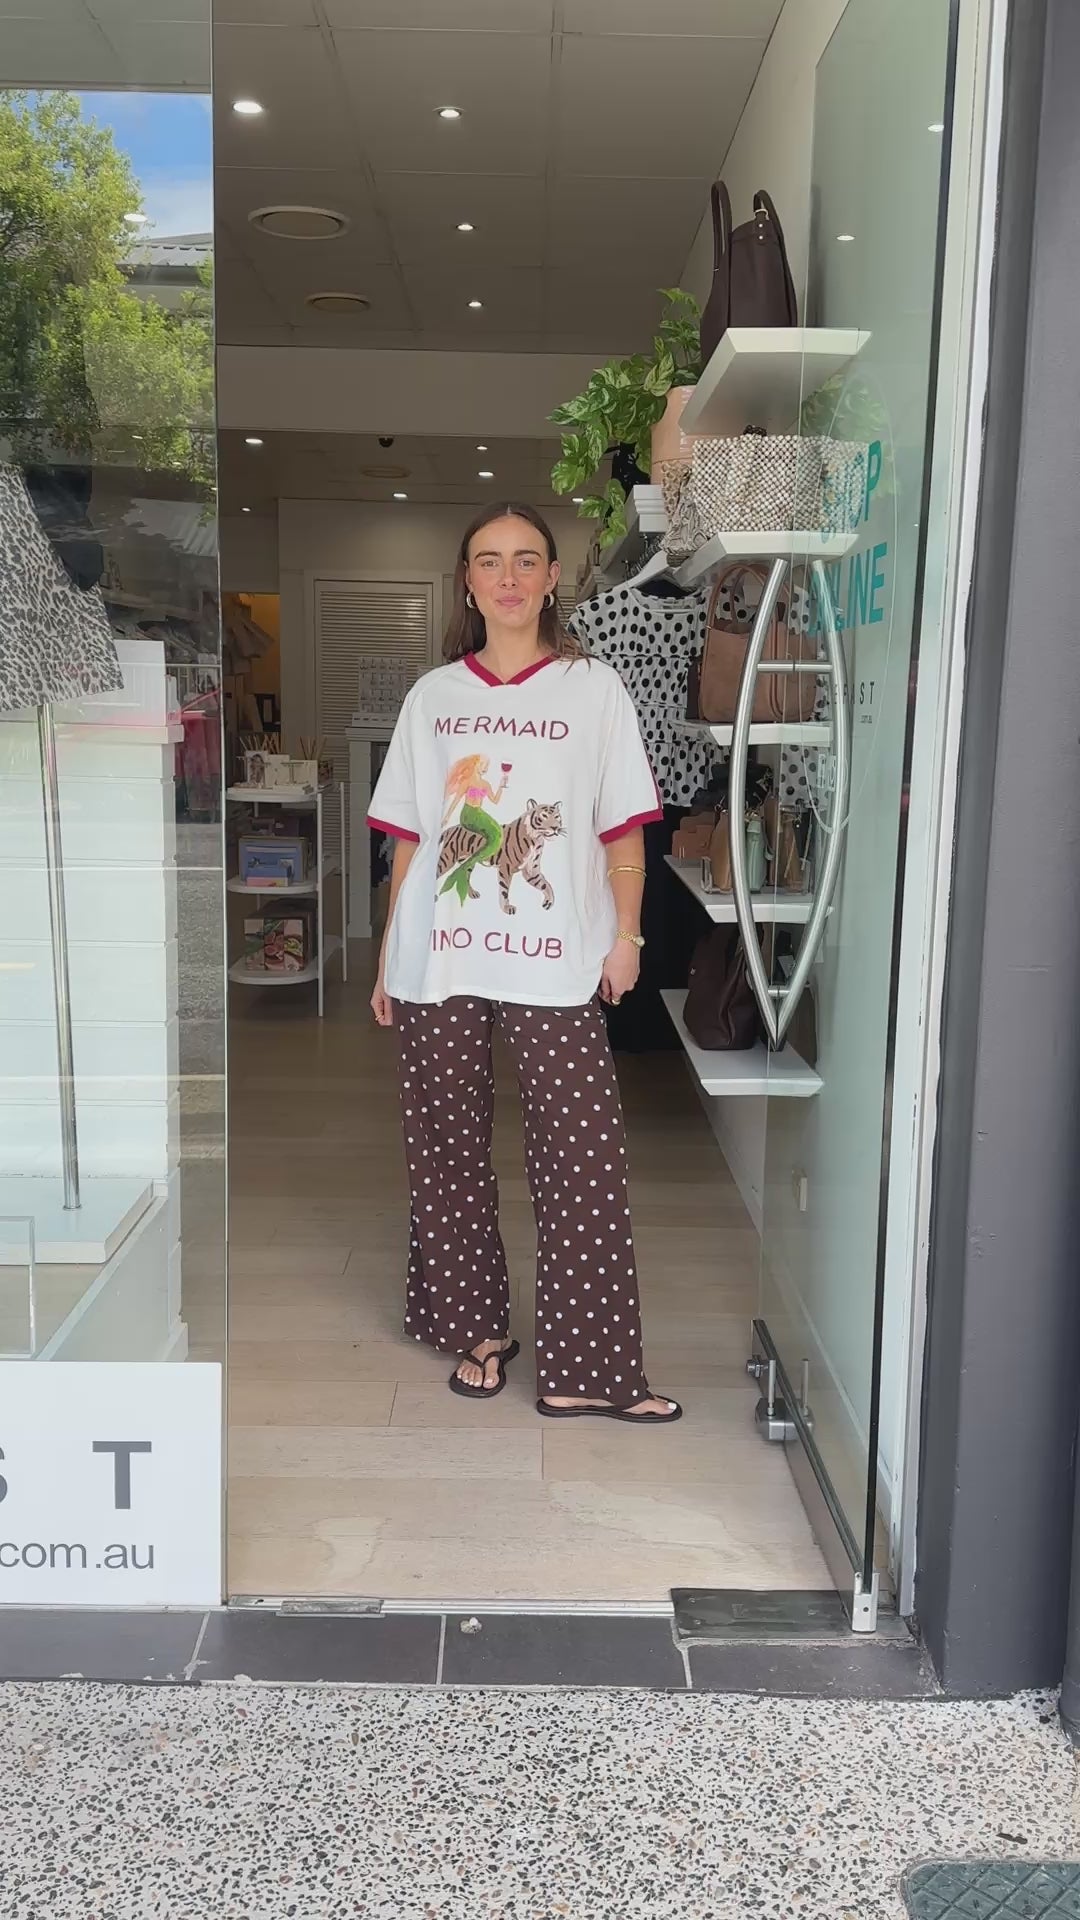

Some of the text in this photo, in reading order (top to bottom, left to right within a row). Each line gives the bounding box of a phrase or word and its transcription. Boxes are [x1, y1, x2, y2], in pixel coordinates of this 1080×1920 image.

[434, 716, 569, 740] MERMAID
[431, 927, 562, 959] INO CLUB
